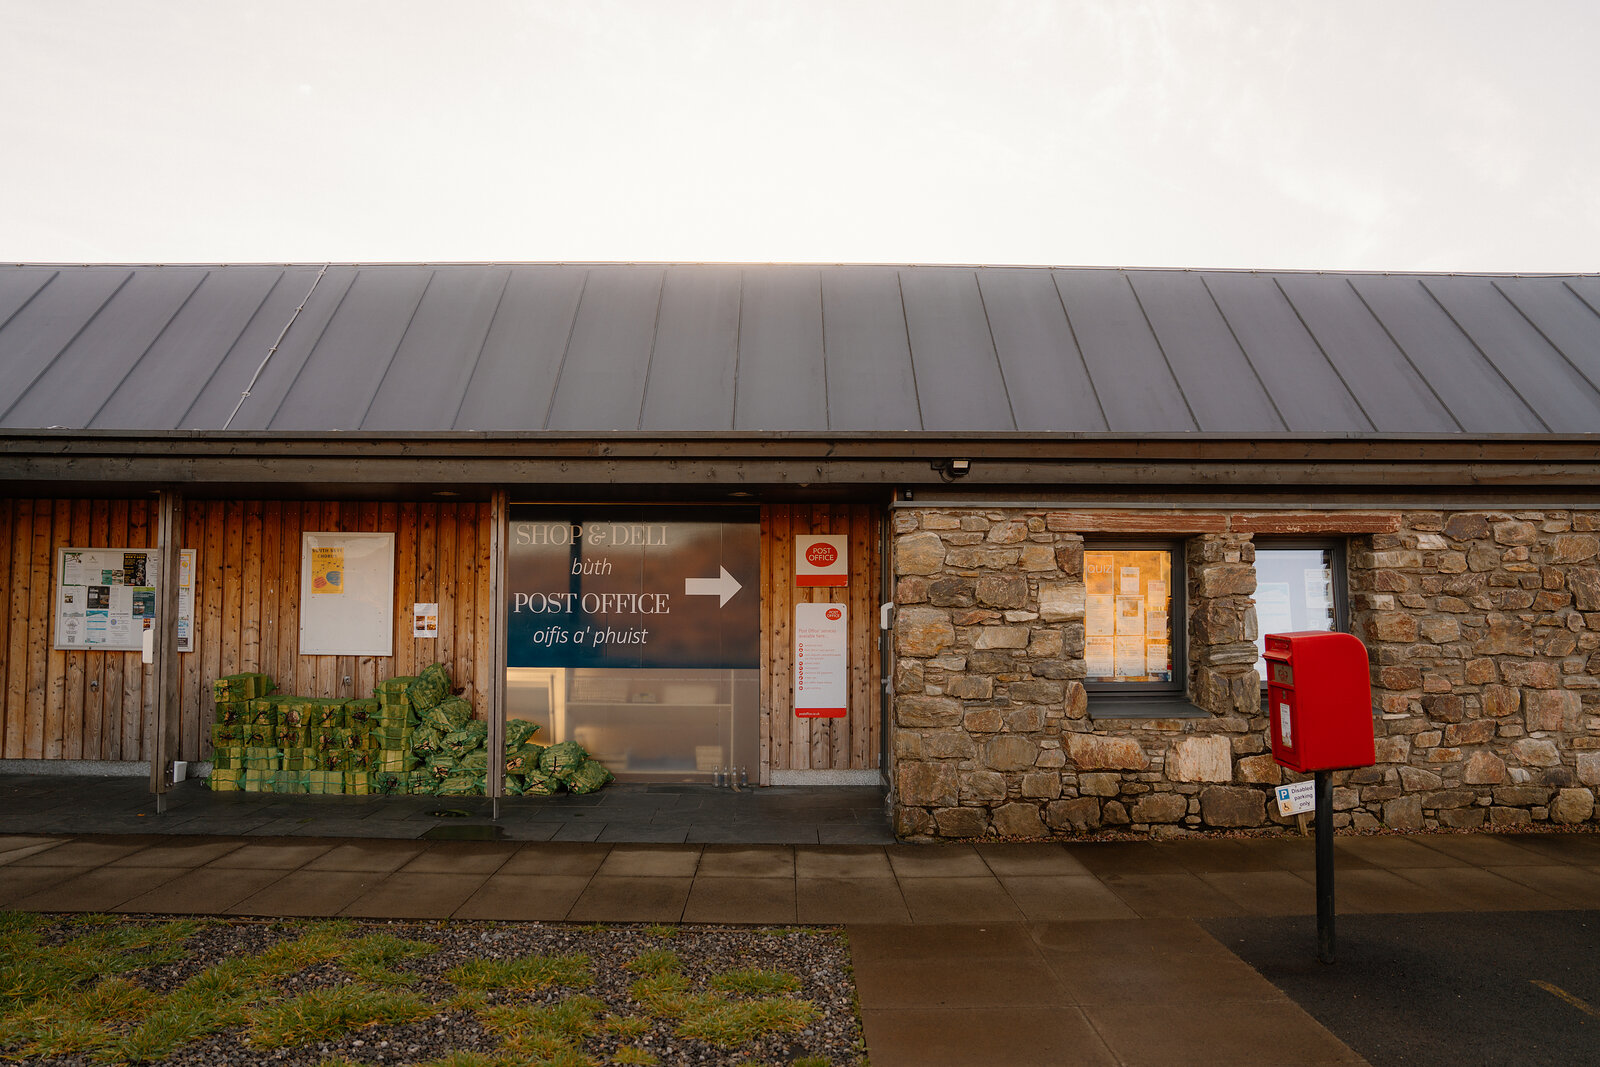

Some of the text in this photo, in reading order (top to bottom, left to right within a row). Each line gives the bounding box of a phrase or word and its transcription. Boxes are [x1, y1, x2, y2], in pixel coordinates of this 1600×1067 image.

[516, 524, 668, 546] SHOP & DELI
[808, 554, 834, 562] OFFICE
[571, 558, 612, 575] bùth
[1087, 564, 1113, 575] QUIZ
[513, 592, 670, 614] POST OFFICE
[533, 626, 648, 647] oifis a' phuist
[1291, 785, 1313, 794] Disabled
[1294, 793, 1313, 801] parking
